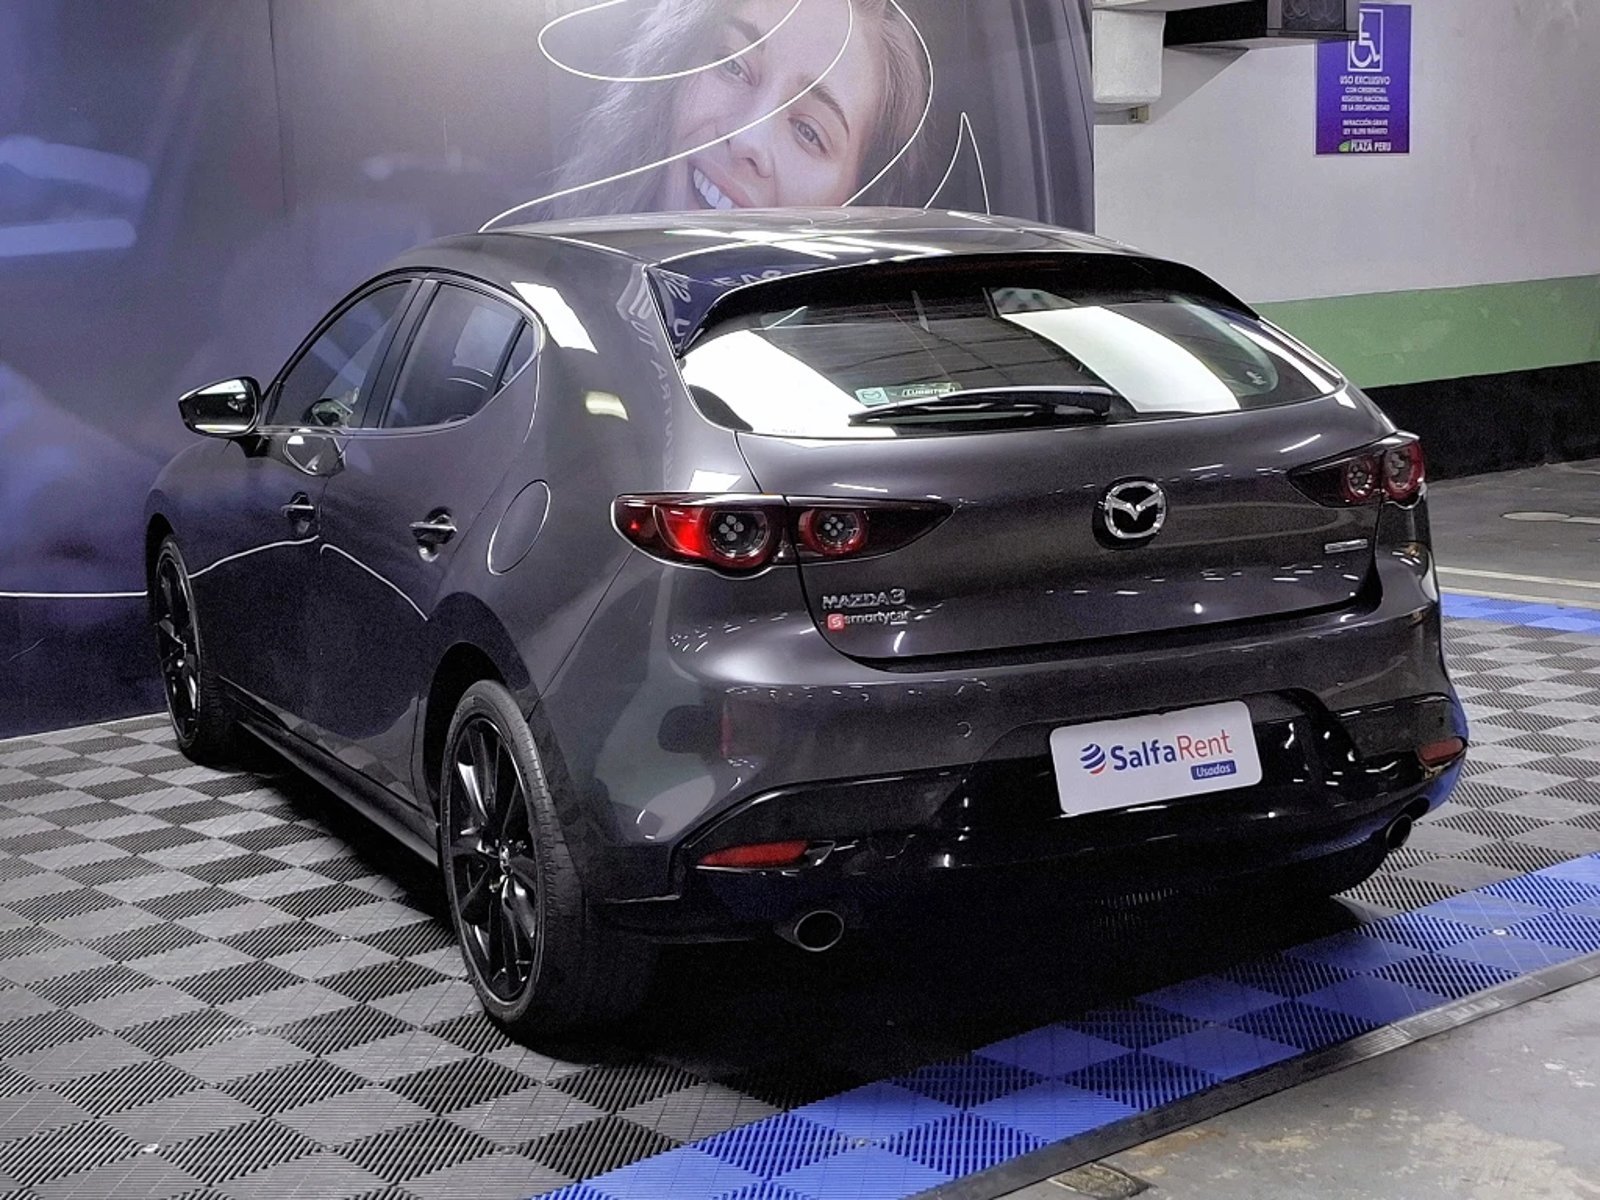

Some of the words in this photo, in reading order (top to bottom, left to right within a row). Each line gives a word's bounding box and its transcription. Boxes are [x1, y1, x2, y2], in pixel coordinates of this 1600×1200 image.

[1339, 75, 1354, 85] USO
[1354, 75, 1391, 85] EXCLUSIVO
[1351, 139, 1373, 152] PLAZA
[1110, 729, 1233, 771] SalfaRent
[1195, 764, 1231, 778] Usados
